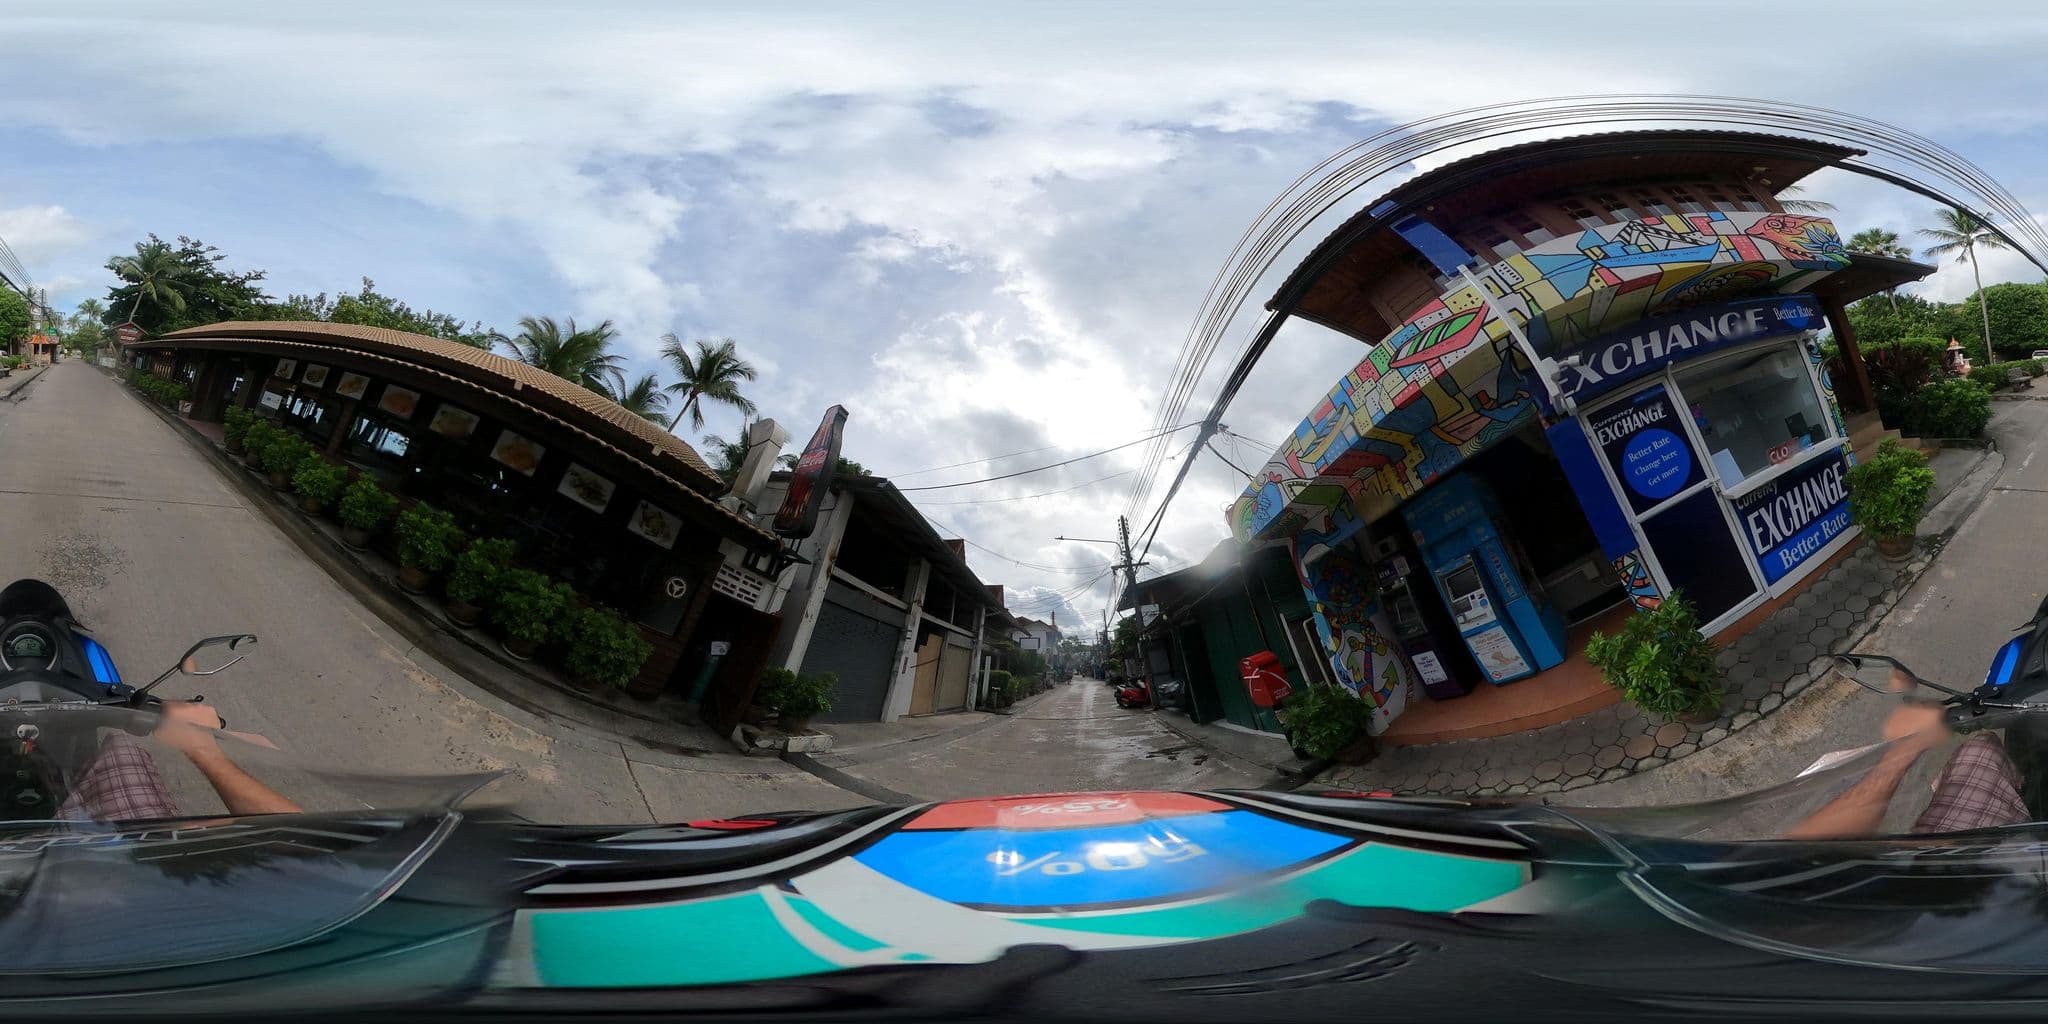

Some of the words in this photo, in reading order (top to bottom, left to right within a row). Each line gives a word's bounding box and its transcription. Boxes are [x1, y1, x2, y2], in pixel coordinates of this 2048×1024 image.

[1556, 307, 1767, 400] EXCHANGE
[1773, 307, 1795, 321] Better
[1796, 304, 1814, 319] Rate
[1593, 406, 1635, 431] Currency
[1597, 403, 1668, 446] EXCHANGE
[1627, 445, 1653, 463] Better
[1652, 435, 1671, 450] Rate
[1635, 457, 1661, 476] Change
[1661, 449, 1679, 463] here
[1647, 476, 1661, 487] Get
[1661, 465, 1679, 478] more
[1736, 481, 1779, 510] Currency
[1747, 461, 1849, 556] EXCHANGE
[1778, 524, 1820, 571] Better
[1819, 510, 1848, 547] Rate
[985, 831, 1207, 877] 50%
